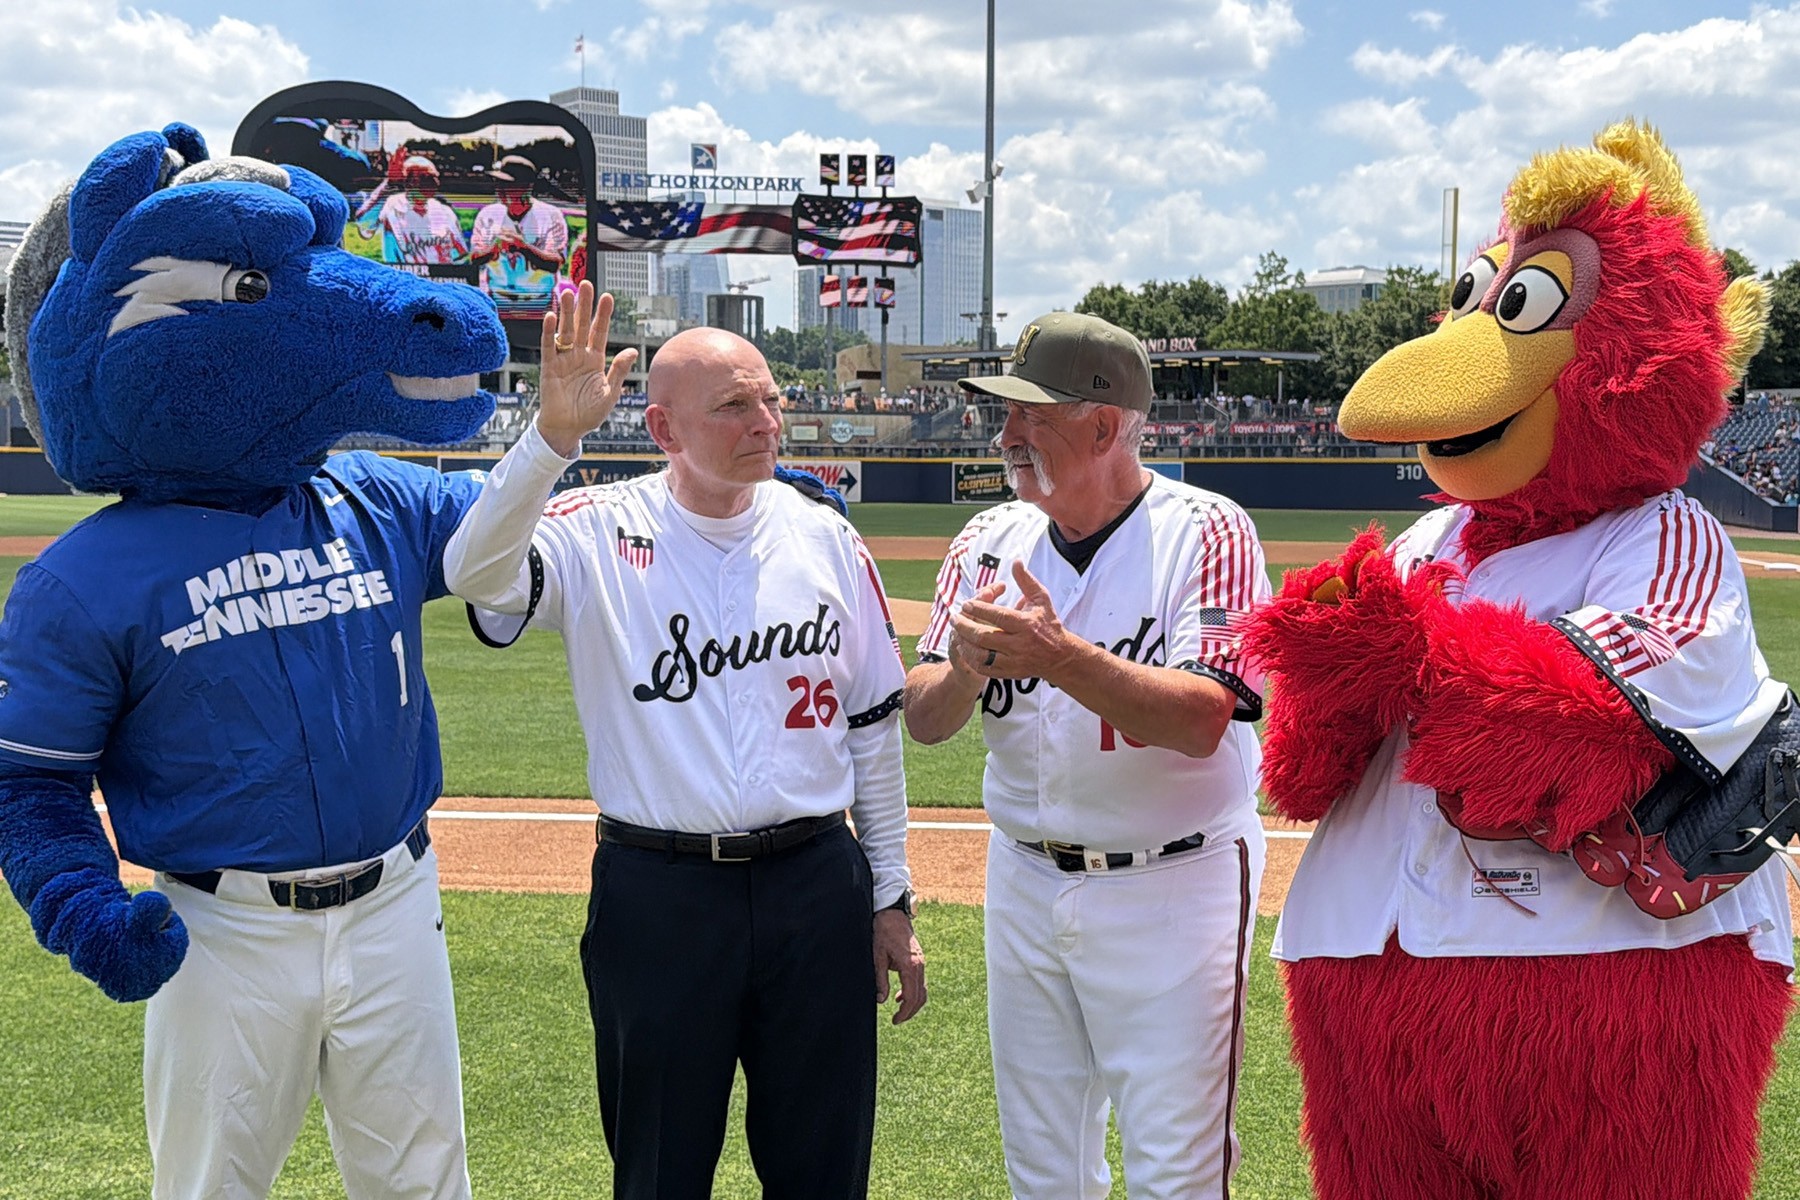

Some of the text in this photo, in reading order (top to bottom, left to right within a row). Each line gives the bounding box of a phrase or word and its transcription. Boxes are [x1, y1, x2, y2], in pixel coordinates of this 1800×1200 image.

[601, 173, 806, 192] FIRST HORIZON PARK
[1169, 336, 1197, 352] BOX
[1165, 424, 1186, 434] TOPS
[1233, 424, 1296, 434] TOYOTA TOPS
[560, 473, 576, 483] LT
[579, 468, 600, 486] V
[1396, 464, 1422, 480] 310
[185, 537, 355, 615] MIDDLE
[160, 570, 394, 655] TENNESSEE
[633, 602, 841, 703] Sounds
[390, 631, 408, 707] 1
[785, 675, 839, 729] 26
[1100, 714, 1150, 752] 1
[1090, 857, 1102, 869] 16
